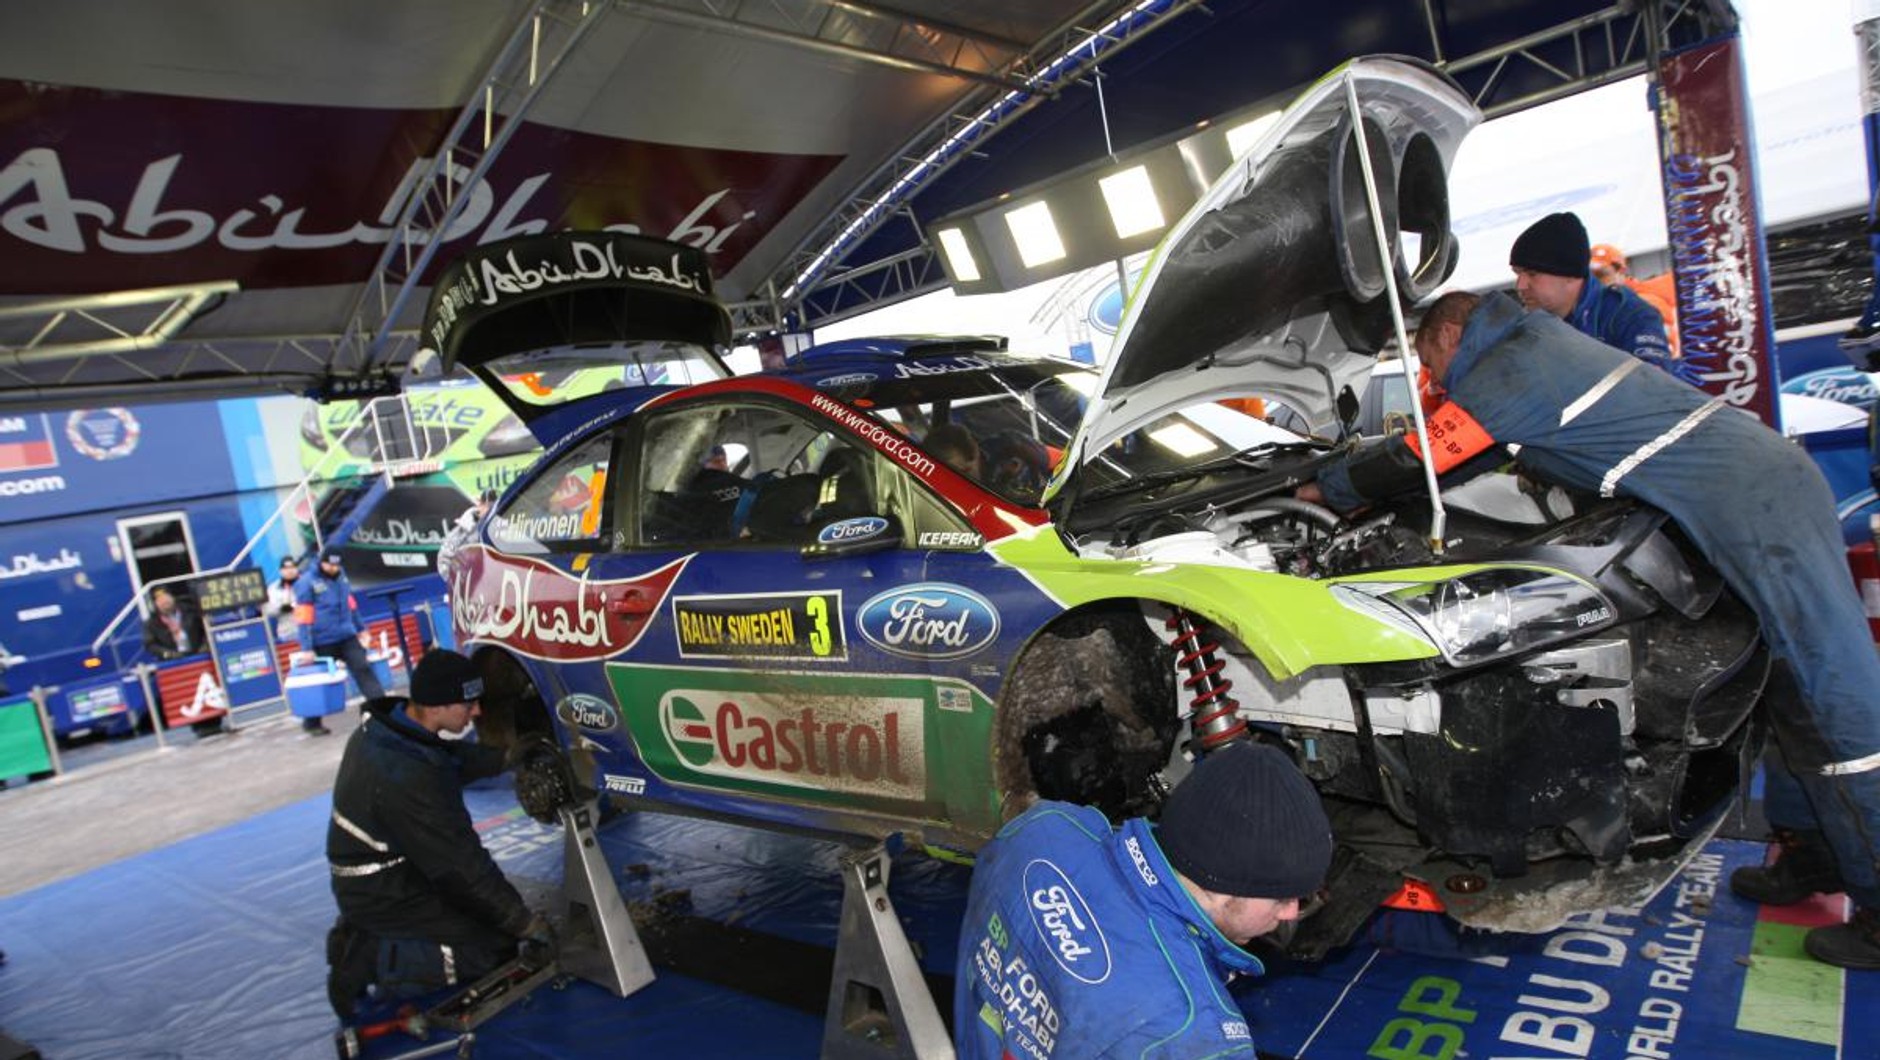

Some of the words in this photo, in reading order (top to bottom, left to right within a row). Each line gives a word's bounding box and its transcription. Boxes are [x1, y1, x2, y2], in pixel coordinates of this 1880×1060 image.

[811, 394, 936, 477] www.wrcford.com
[508, 513, 578, 538] Hirvonen
[831, 519, 876, 538] Ford
[918, 532, 982, 546] ICEPEAK
[494, 564, 613, 647] Dhabi
[679, 609, 724, 644] RALLY
[726, 608, 796, 646] SWEDEN
[805, 595, 832, 657] 3
[883, 596, 970, 647] Ford
[571, 698, 609, 728] Ford
[715, 701, 912, 785] Castrol
[1032, 885, 1092, 961] Ford
[1648, 911, 1707, 992] RALLY
[988, 911, 1009, 951] BP
[1005, 955, 1060, 1035] FORD
[1000, 982, 1055, 1054] DHABI
[1366, 976, 1479, 1060] BP
